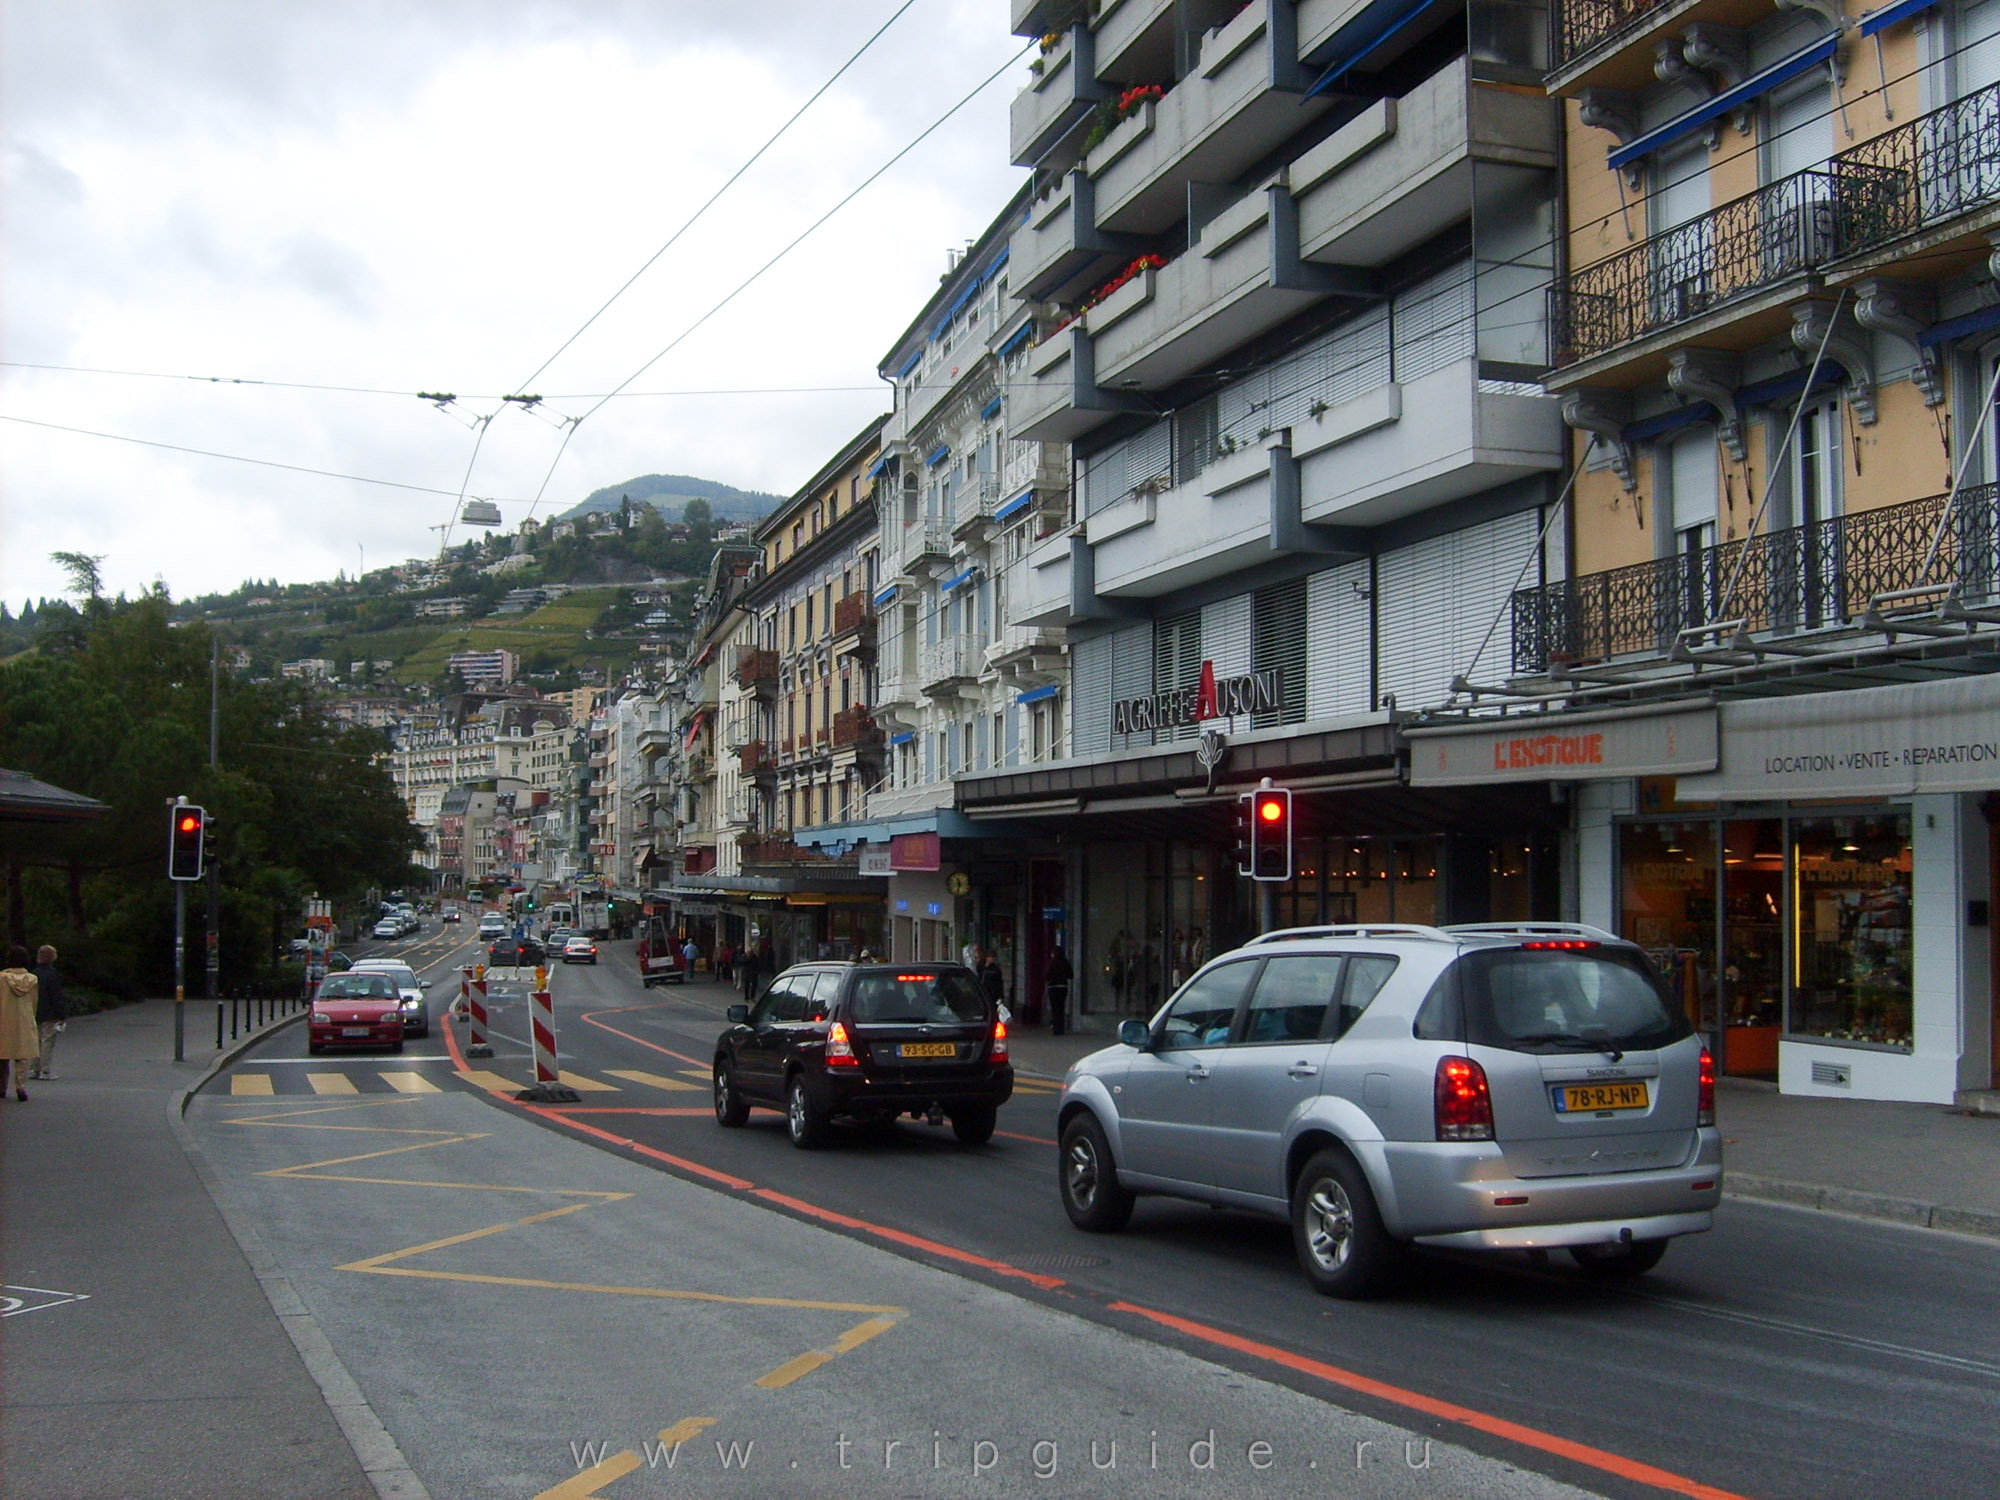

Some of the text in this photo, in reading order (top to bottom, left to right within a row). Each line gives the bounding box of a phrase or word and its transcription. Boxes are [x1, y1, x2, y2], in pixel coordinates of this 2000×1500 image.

[1129, 687, 1190, 732] GRIFFE
[1192, 659, 1280, 721] AUSONI
[1765, 743, 1998, 774] LOCATION VENTE REPARATION
[1568, 1086, 1640, 1108] 78-RJ-NP
